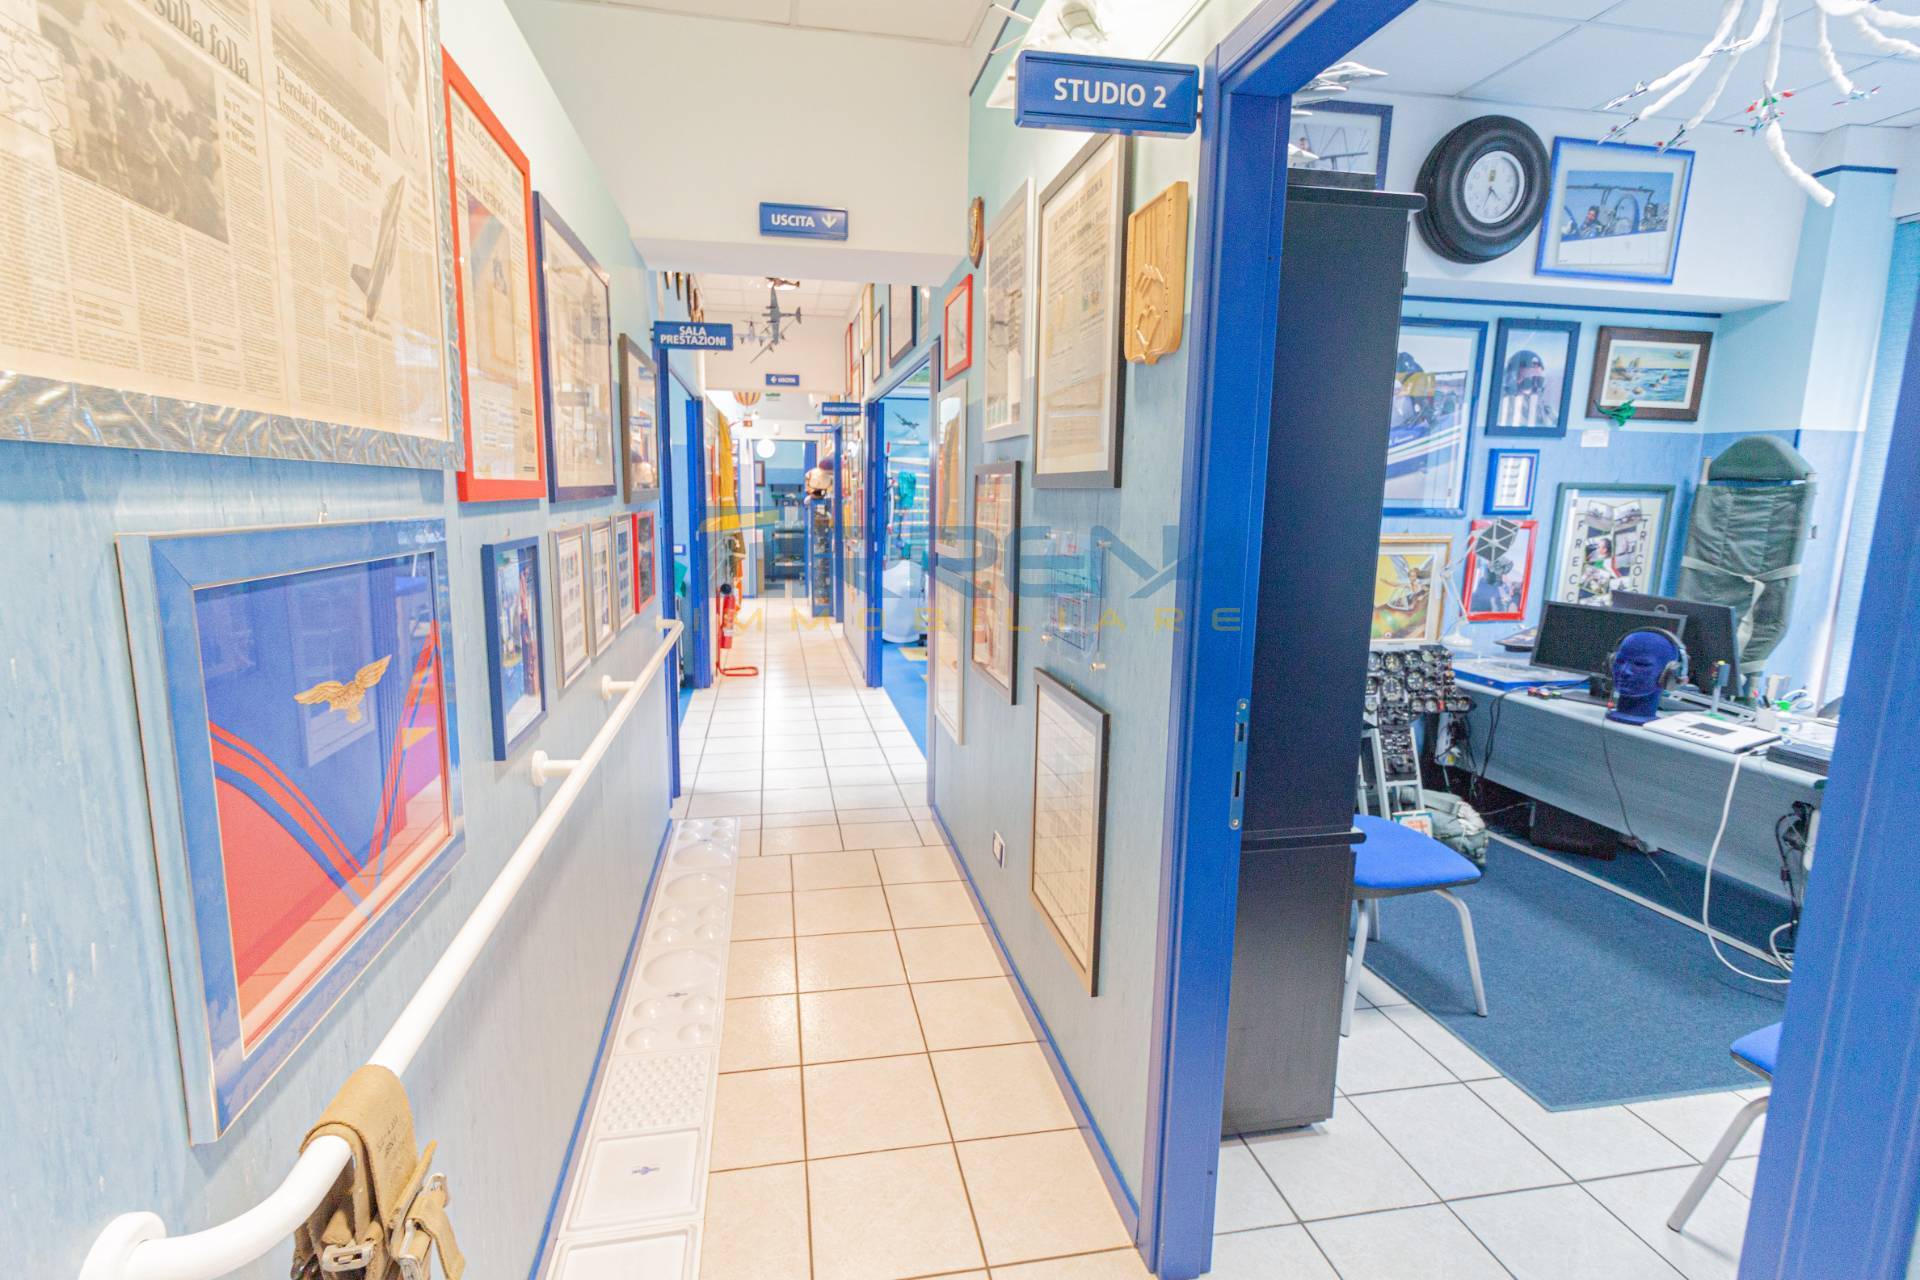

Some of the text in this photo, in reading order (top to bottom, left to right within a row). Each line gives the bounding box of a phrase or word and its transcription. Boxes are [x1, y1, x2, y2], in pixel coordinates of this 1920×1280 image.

[154, 0, 250, 83] sulla folla
[1054, 77, 1167, 109] STUDIO 2
[771, 213, 816, 228] USCITA
[679, 325, 707, 337] SALA
[660, 334, 726, 346] PRESTAZIONI
